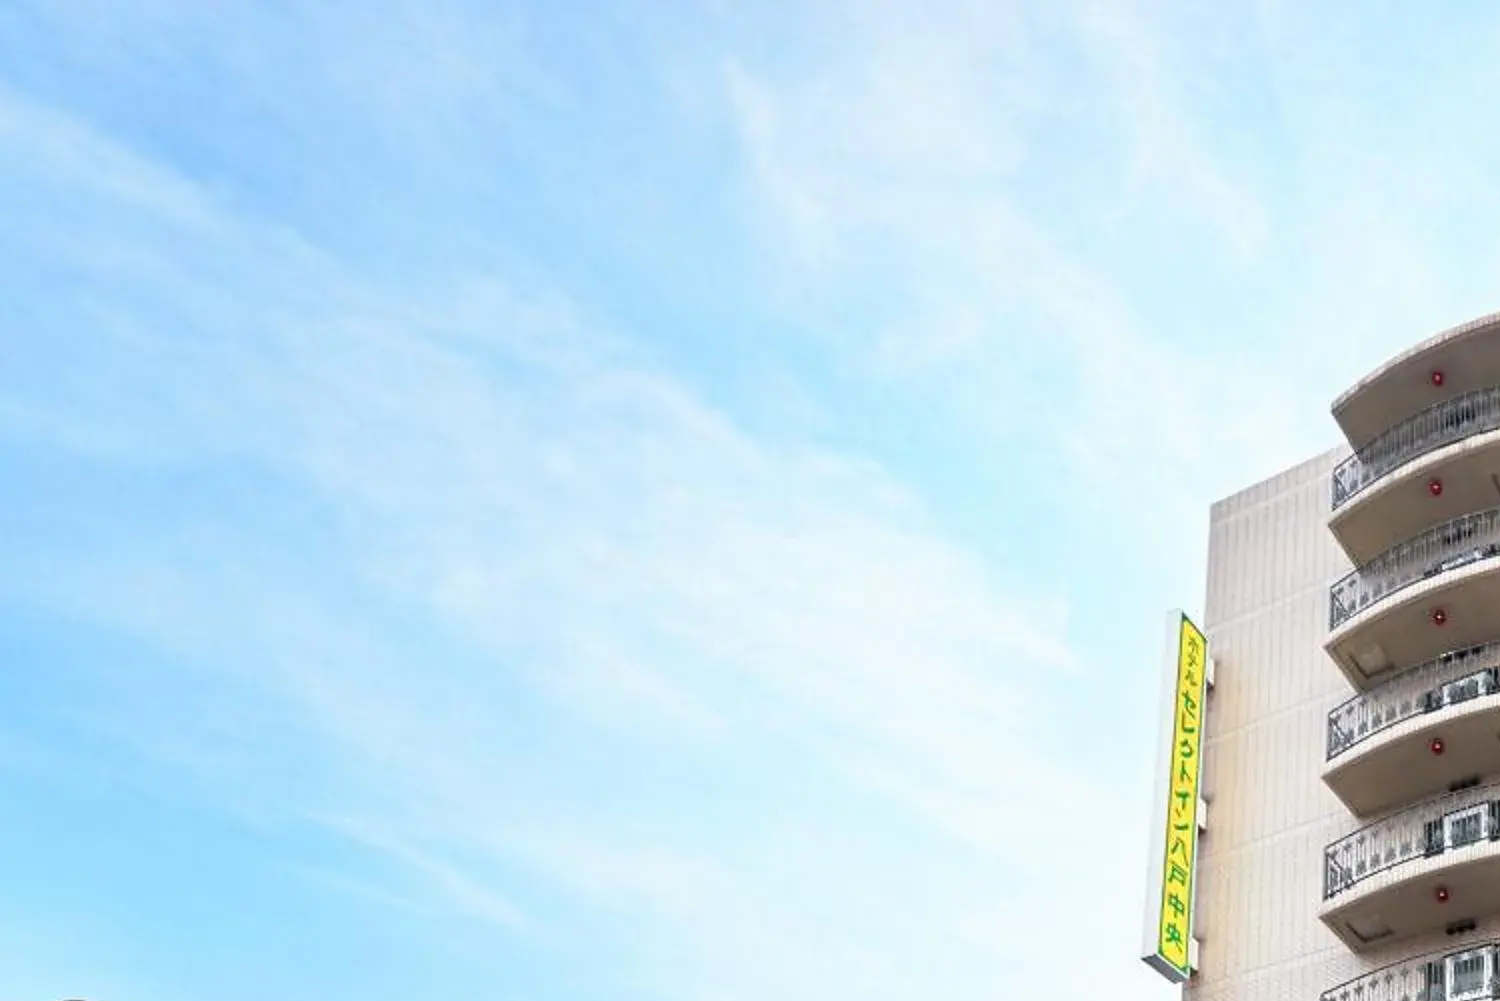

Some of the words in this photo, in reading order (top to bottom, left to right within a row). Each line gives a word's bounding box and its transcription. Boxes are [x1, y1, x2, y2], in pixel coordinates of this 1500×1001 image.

[1164, 634, 1199, 955] ホテルセレクトイン八戸中央
